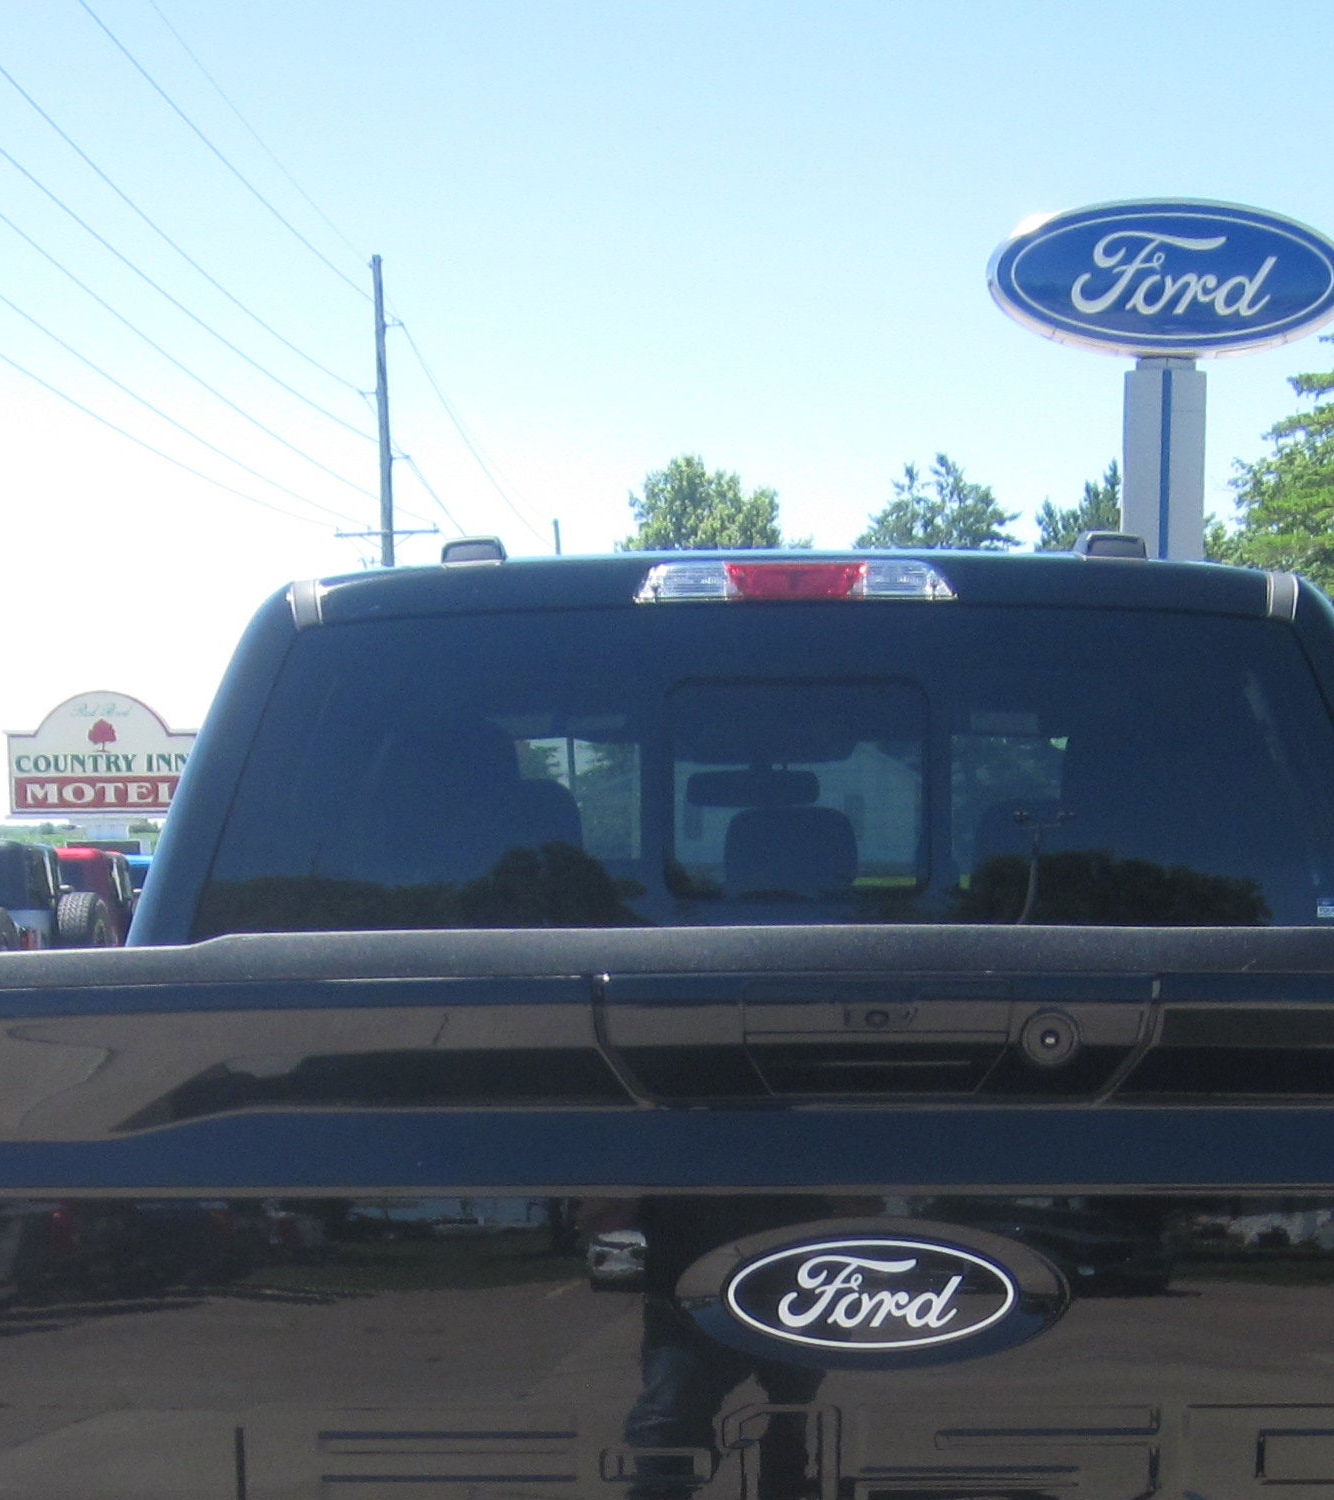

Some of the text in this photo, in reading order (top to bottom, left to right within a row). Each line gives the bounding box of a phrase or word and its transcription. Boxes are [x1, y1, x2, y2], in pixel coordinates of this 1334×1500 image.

[1071, 230, 1278, 316] Ford
[16, 753, 136, 773] COUNTRY
[777, 1254, 963, 1328] Ford
